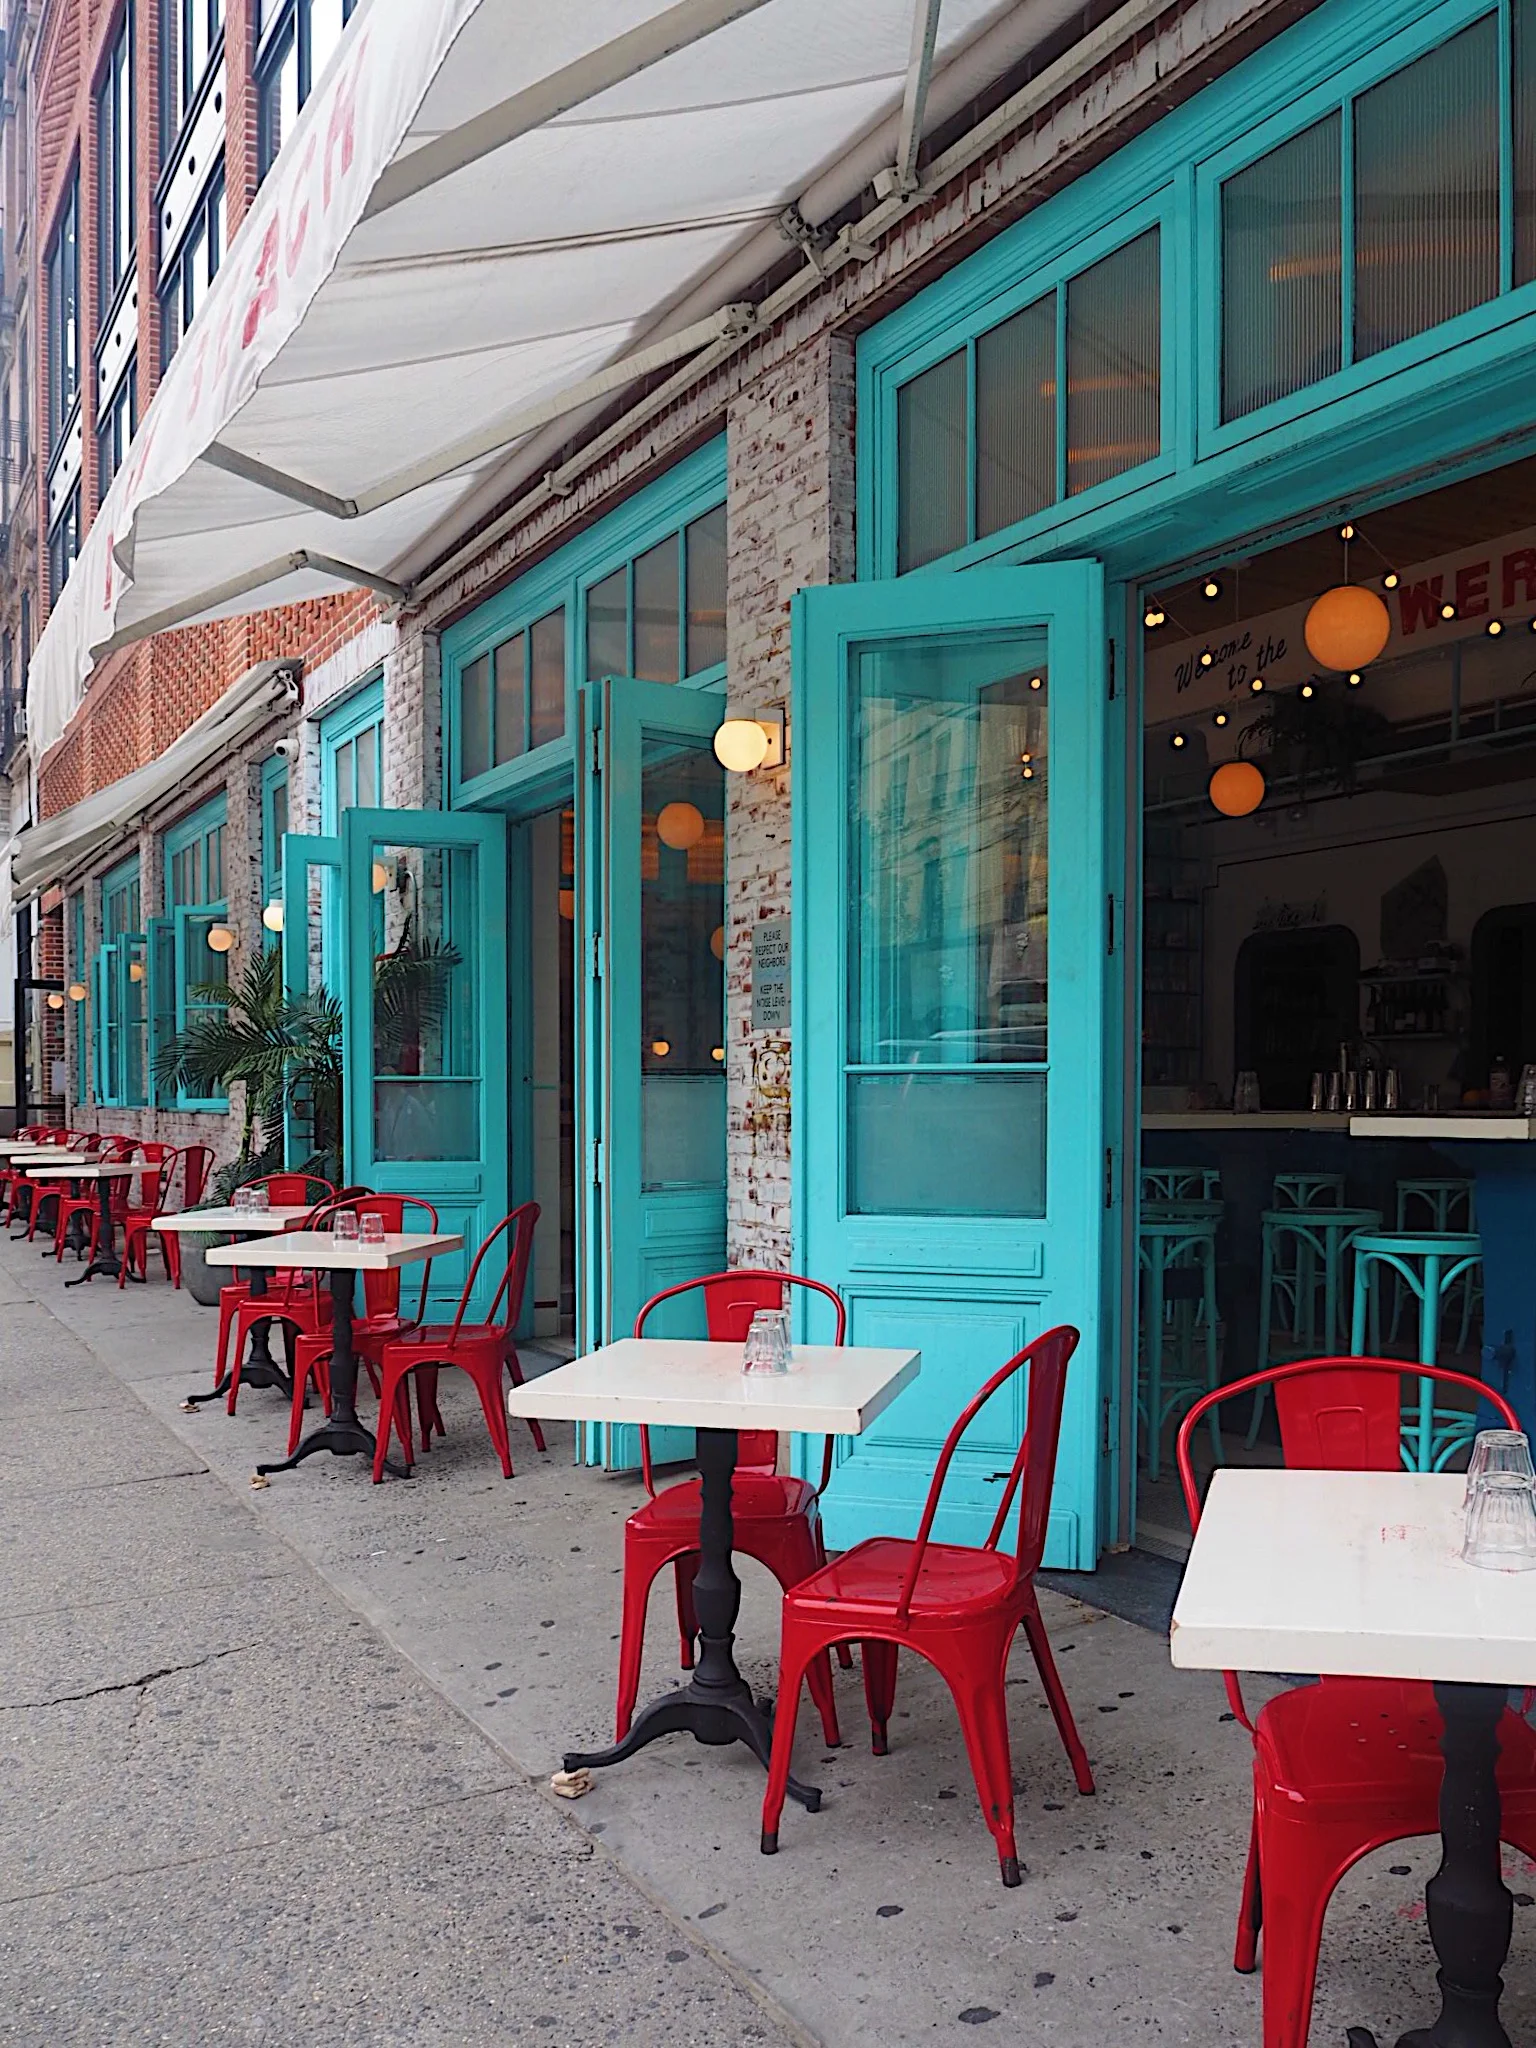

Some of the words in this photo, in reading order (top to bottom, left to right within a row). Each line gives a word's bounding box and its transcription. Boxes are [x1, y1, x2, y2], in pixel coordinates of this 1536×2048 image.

[1379, 547, 1536, 636] WER
[1174, 632, 1253, 694] Wecome
[1227, 664, 1247, 691] to
[1256, 635, 1287, 672] the
[763, 930, 781, 942] PLEASE
[755, 944, 776, 956] RESPECT
[777, 943, 789, 954] OUR
[758, 956, 786, 968] NEIGHBORS
[760, 984, 772, 994] KEEP
[773, 983, 784, 993] THE
[756, 997, 771, 1007] NOISE
[763, 1011, 780, 1020] DOWN
